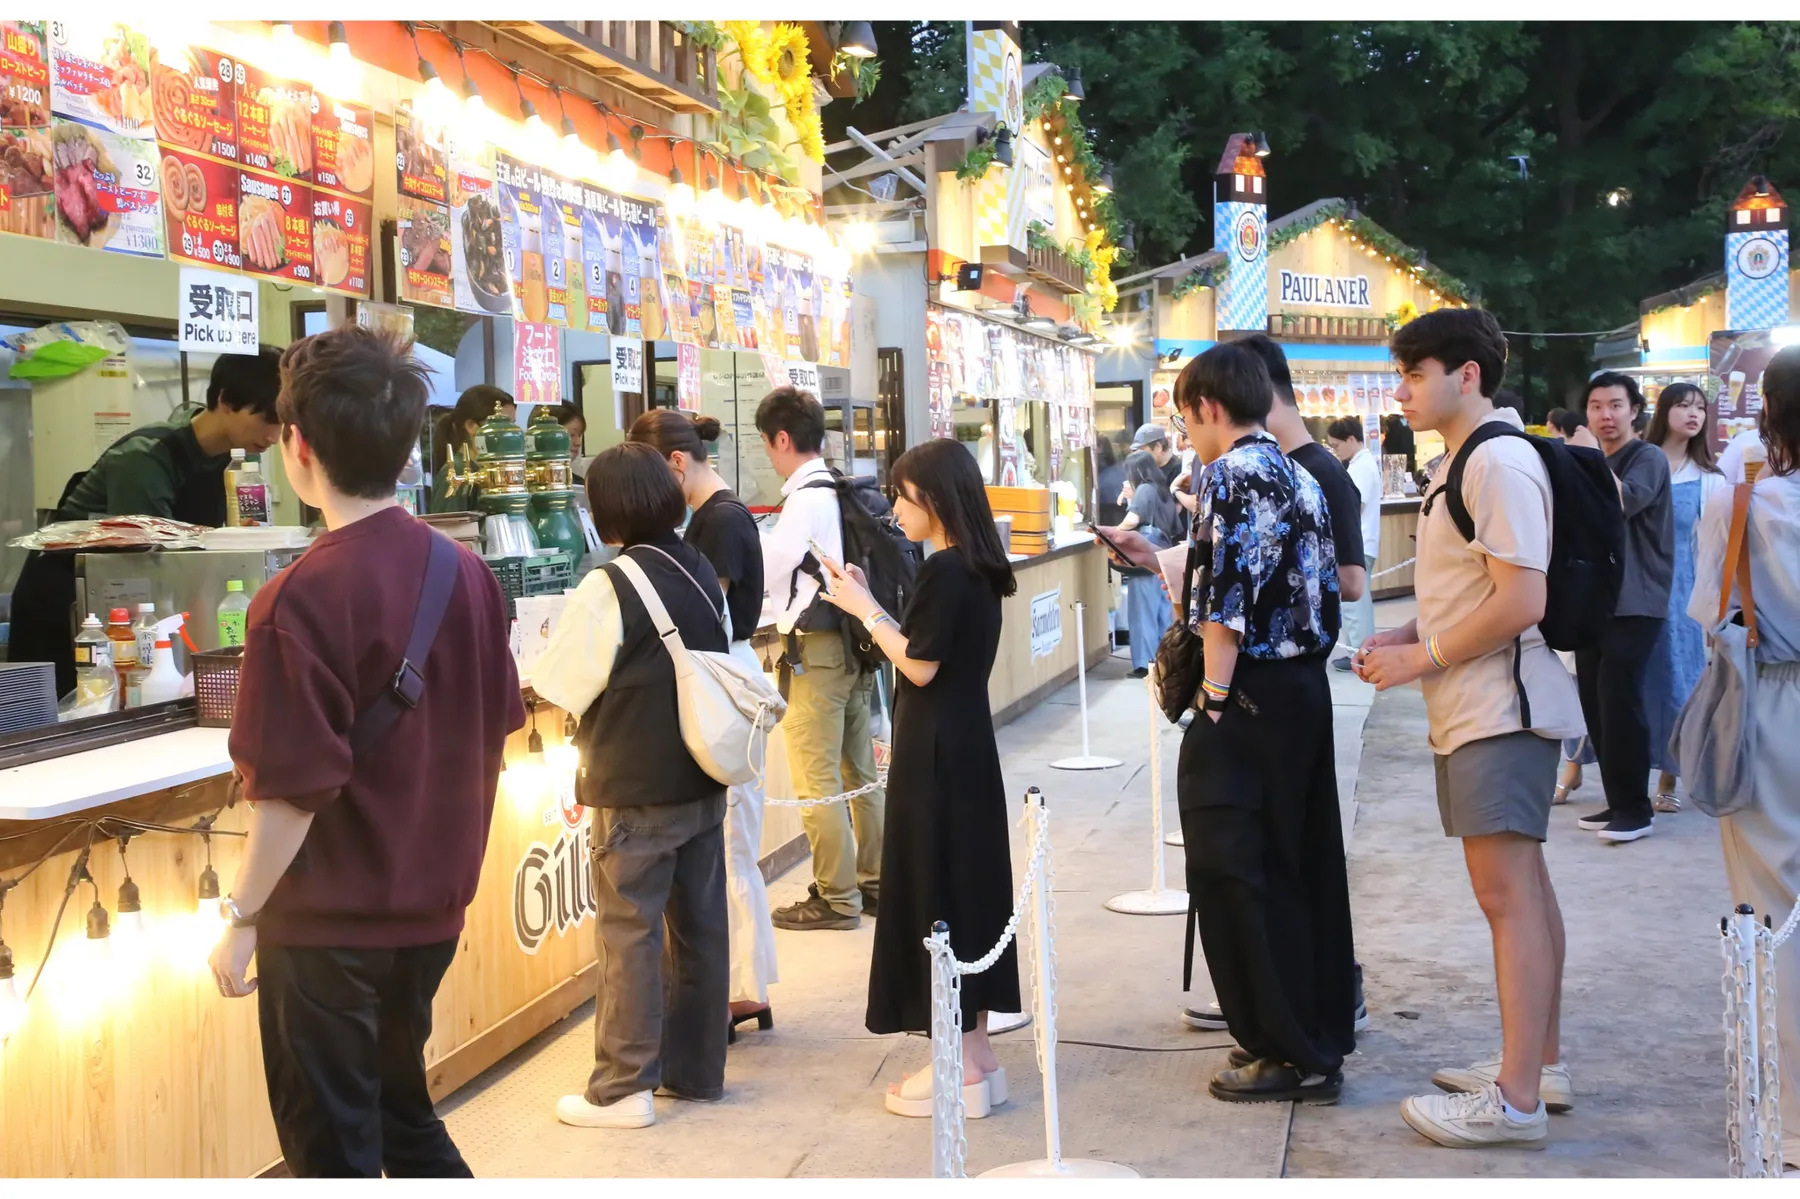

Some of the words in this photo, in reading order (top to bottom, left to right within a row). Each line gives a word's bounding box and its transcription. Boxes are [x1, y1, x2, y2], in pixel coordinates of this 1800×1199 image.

[53, 21, 65, 39] 31
[7, 32, 36, 57] 山盛り
[1, 58, 46, 80] ローストビーフ
[220, 62, 231, 78] 28
[9, 86, 41, 105] ¥1200
[173, 106, 234, 137] ぐるぐるソーセージ
[211, 141, 236, 159] ¥1500
[245, 152, 268, 169] ¥1400
[136, 164, 151, 181] 32
[317, 171, 336, 186] ¥1500
[496, 159, 541, 194] 王道の白ビール
[240, 174, 279, 200] Sausages
[186, 214, 237, 236] ぐるぐるソーセージ
[194, 247, 211, 260] ¥500
[225, 253, 240, 267] ¥900
[293, 265, 310, 278] ¥900
[1281, 271, 1370, 306] PAULANER
[189, 284, 253, 323] 受取口
[185, 323, 214, 342] Pick
[525, 325, 552, 347] フード
[788, 368, 816, 387] 受取口
